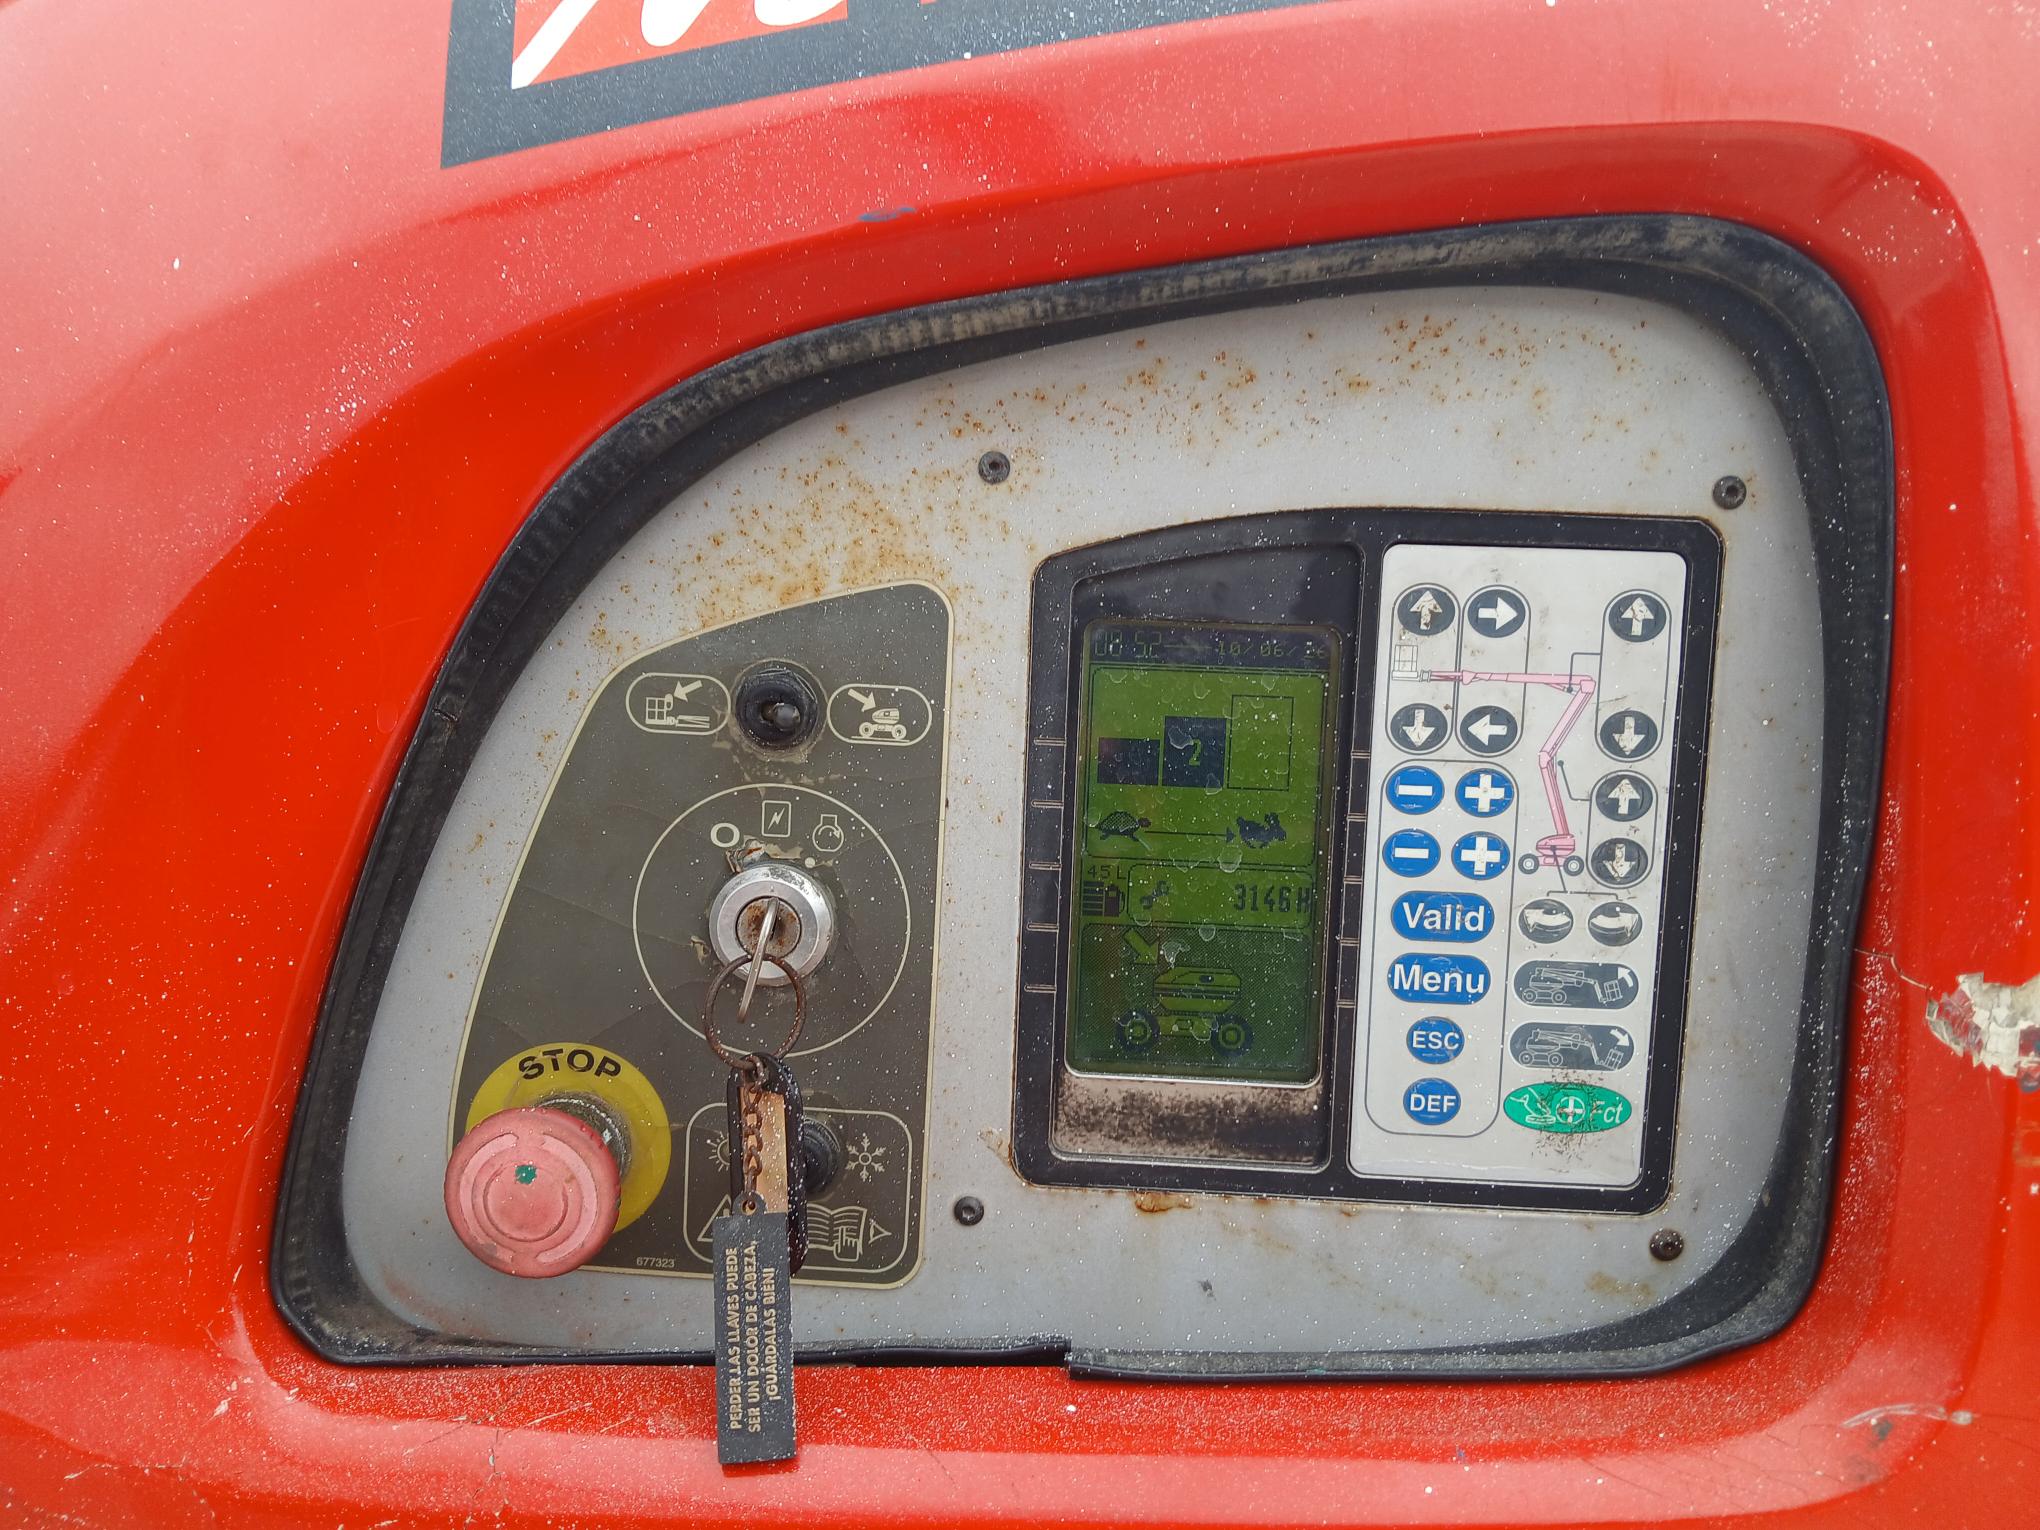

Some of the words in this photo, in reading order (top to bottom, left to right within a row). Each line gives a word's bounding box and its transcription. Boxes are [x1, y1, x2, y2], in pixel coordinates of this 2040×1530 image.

[1402, 902, 1485, 933] Valid
[1393, 963, 1485, 994] Menu
[1411, 1030, 1461, 1051] ESC
[518, 1048, 622, 1080] STOP
[1409, 1092, 1457, 1113] DEF
[1590, 1100, 1624, 1124] Fct
[636, 1256, 675, 1269] 677323
[726, 1247, 738, 1290] PUEDE
[744, 1240, 758, 1300] CABEZA,
[727, 1294, 741, 1344] LLAVES
[746, 1304, 758, 1323] DE
[729, 1347, 742, 1375] LAS
[746, 1327, 760, 1376] DOLOR
[729, 1376, 744, 1430] PERDER
[748, 1380, 760, 1404] UN
[748, 1407, 761, 1433] SER
